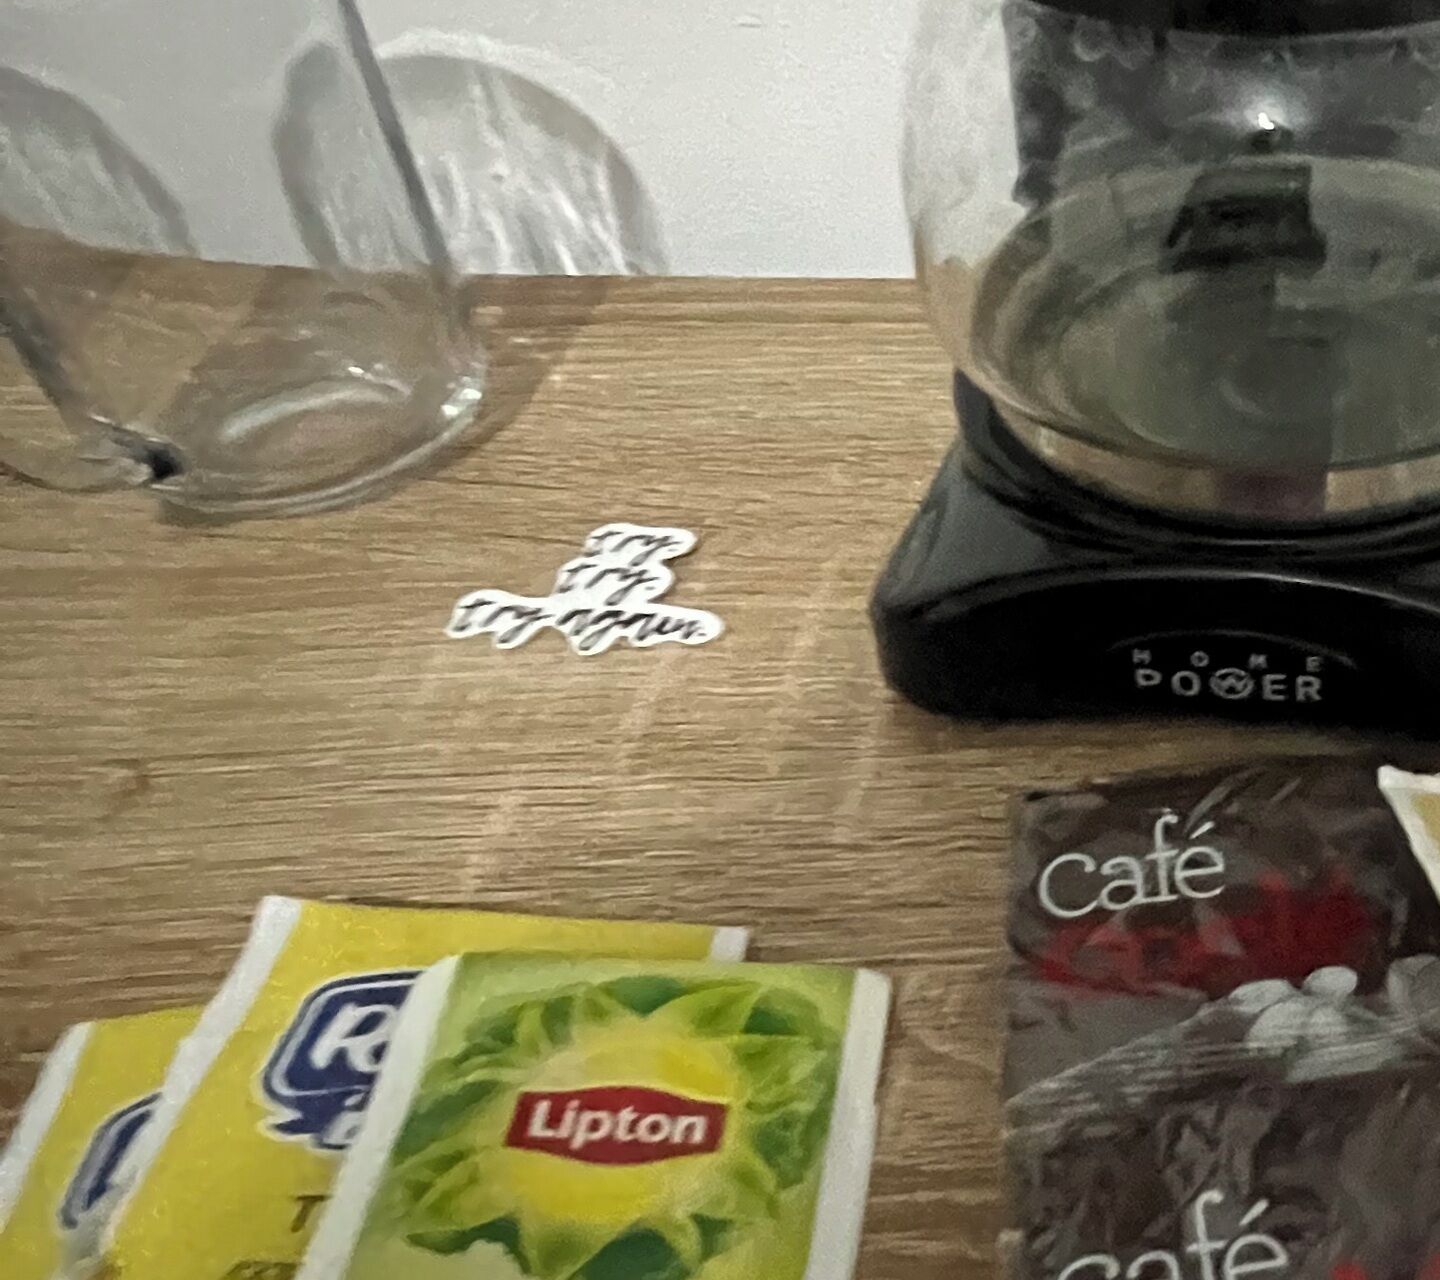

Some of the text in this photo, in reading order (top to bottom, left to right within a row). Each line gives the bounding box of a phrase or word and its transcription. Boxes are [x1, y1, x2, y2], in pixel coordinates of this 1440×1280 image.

[1131, 648, 1322, 671] HOME
[1134, 668, 1322, 701] POWER
[526, 1099, 708, 1151] Lipton
